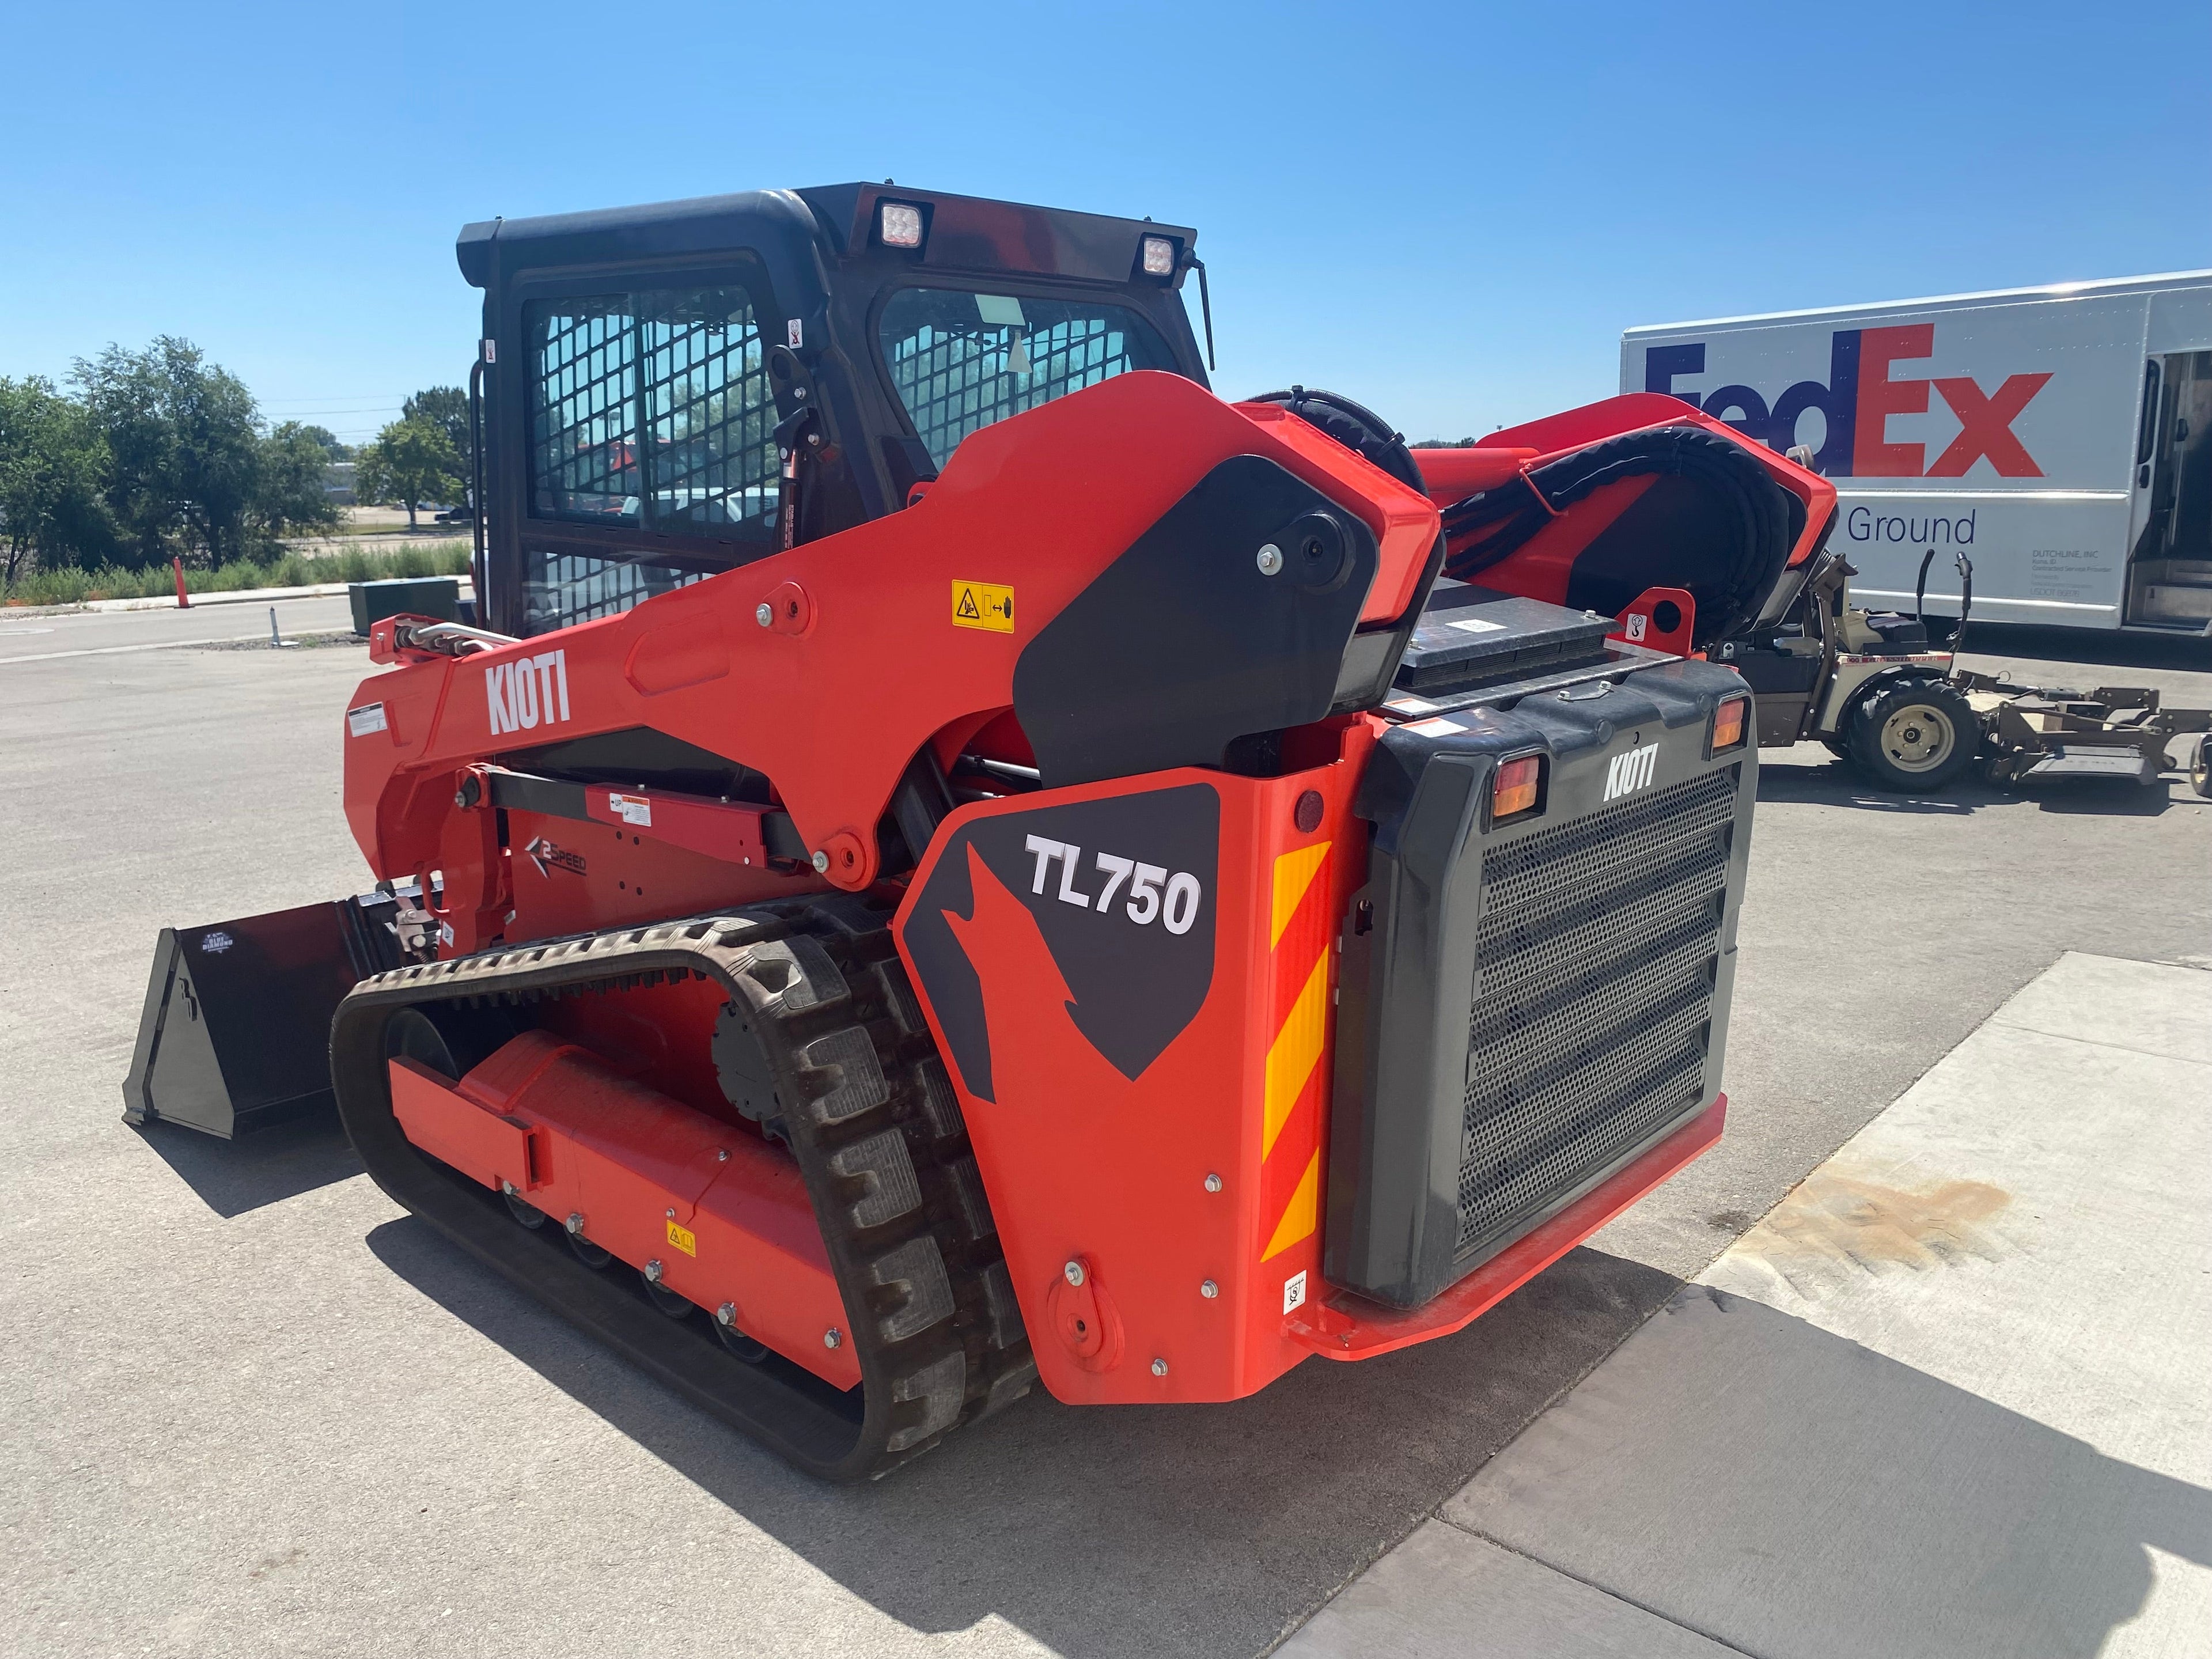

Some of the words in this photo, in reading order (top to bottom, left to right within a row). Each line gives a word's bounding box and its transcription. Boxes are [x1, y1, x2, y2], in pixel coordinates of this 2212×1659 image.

[1848, 506, 1976, 544] Ground
[485, 649, 570, 736] KIOTI
[1603, 742, 1659, 802] KIOTI
